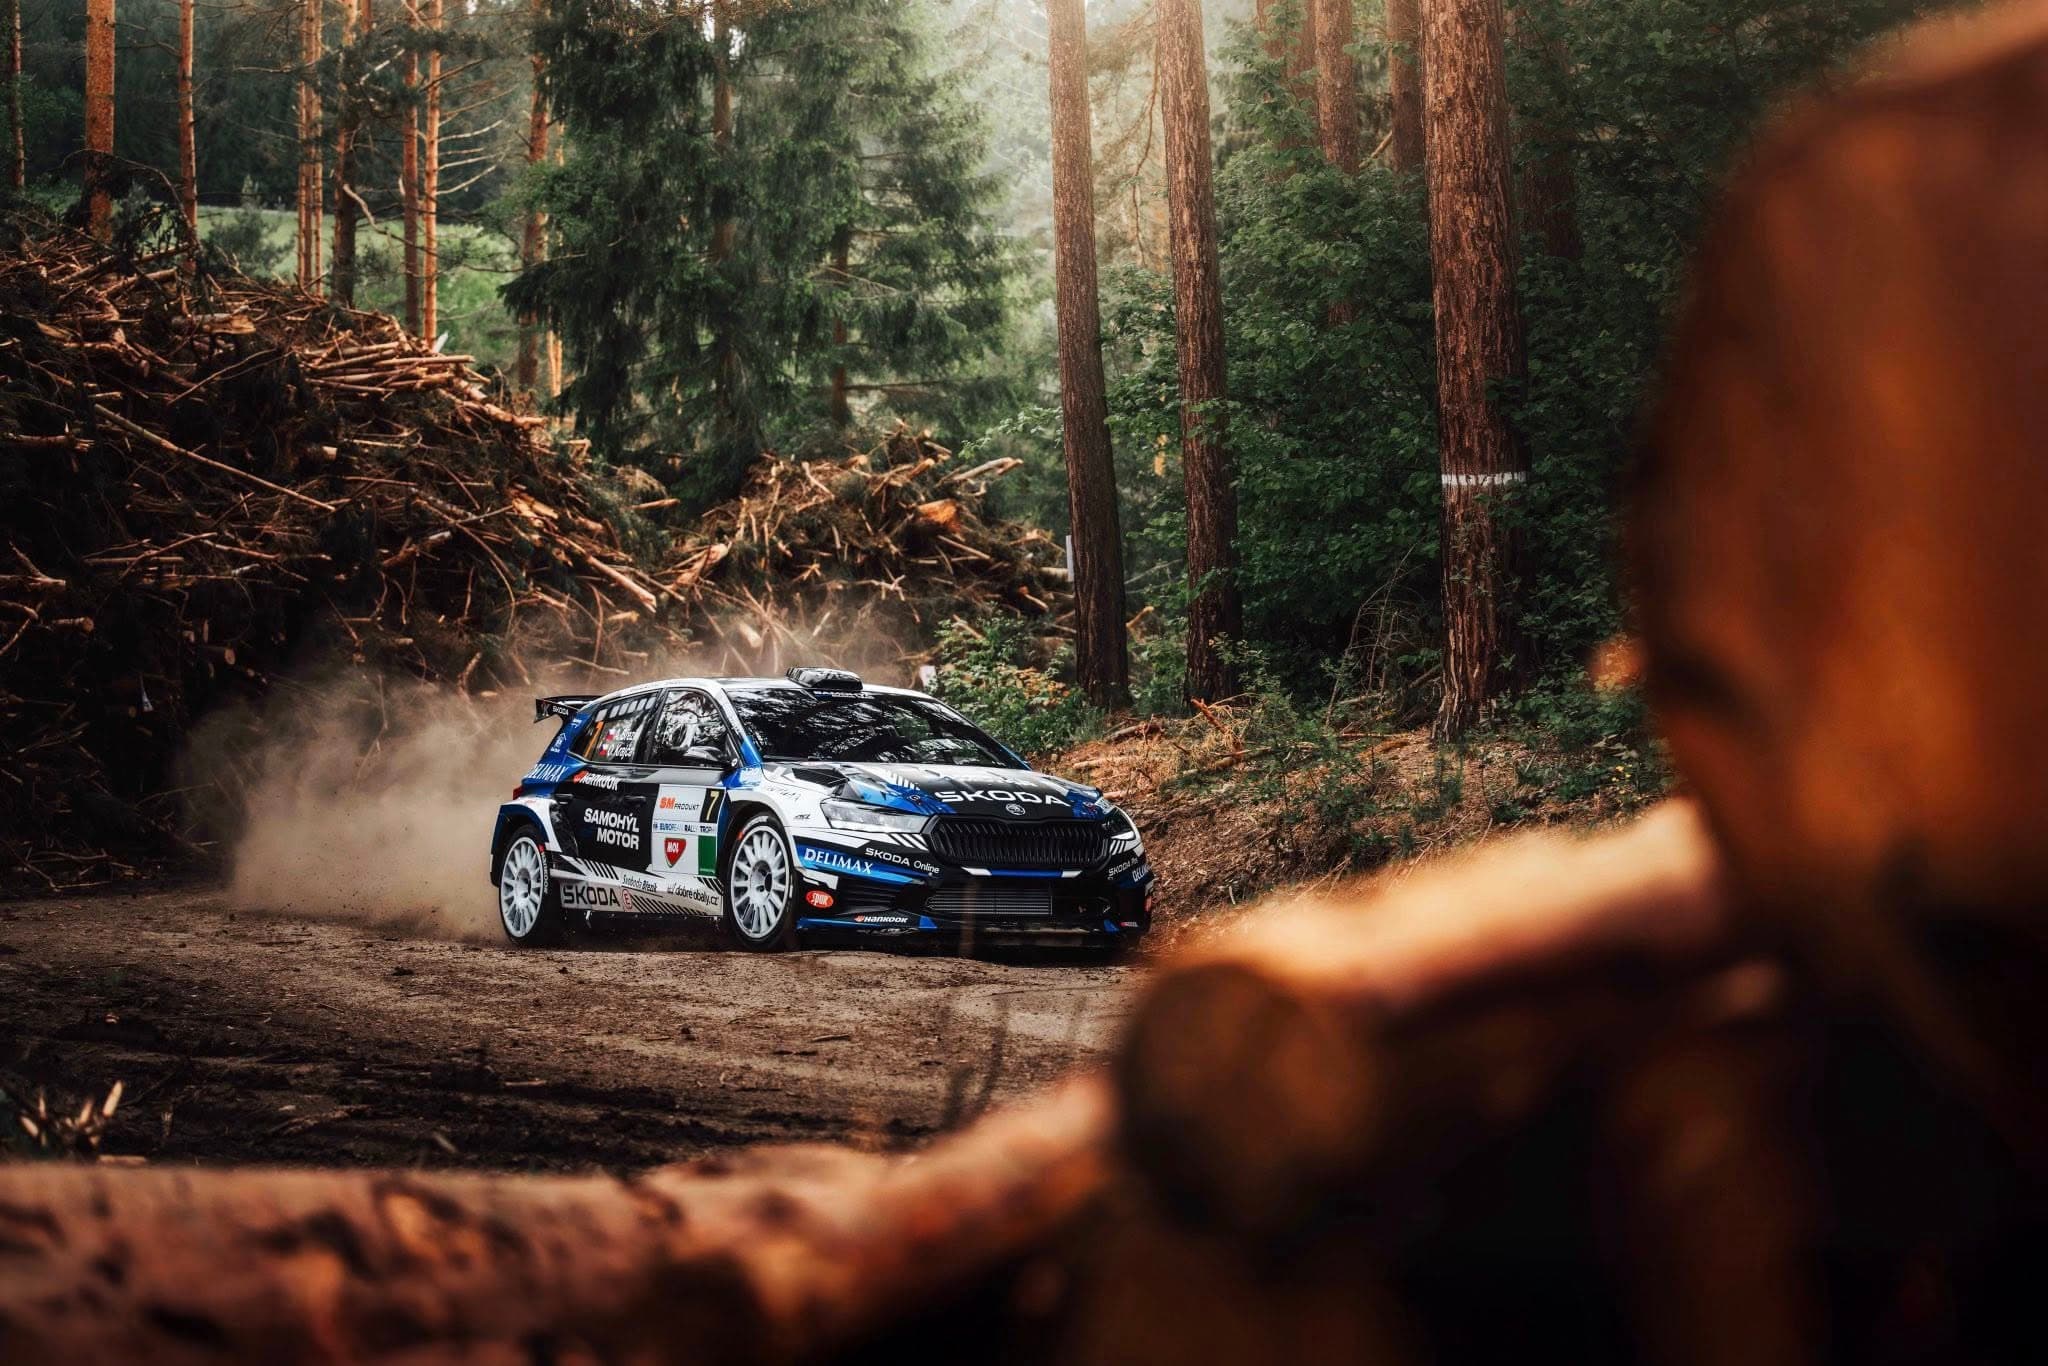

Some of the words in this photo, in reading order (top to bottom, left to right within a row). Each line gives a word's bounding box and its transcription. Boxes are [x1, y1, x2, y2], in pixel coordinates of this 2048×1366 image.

[659, 796, 676, 809] SM
[674, 803, 701, 811] PRODUKT
[706, 790, 720, 821] 7
[583, 807, 640, 833] SAMOHÝL
[596, 827, 640, 850] MOTOR
[803, 847, 874, 875] DELIMAX
[913, 860, 940, 874] Online
